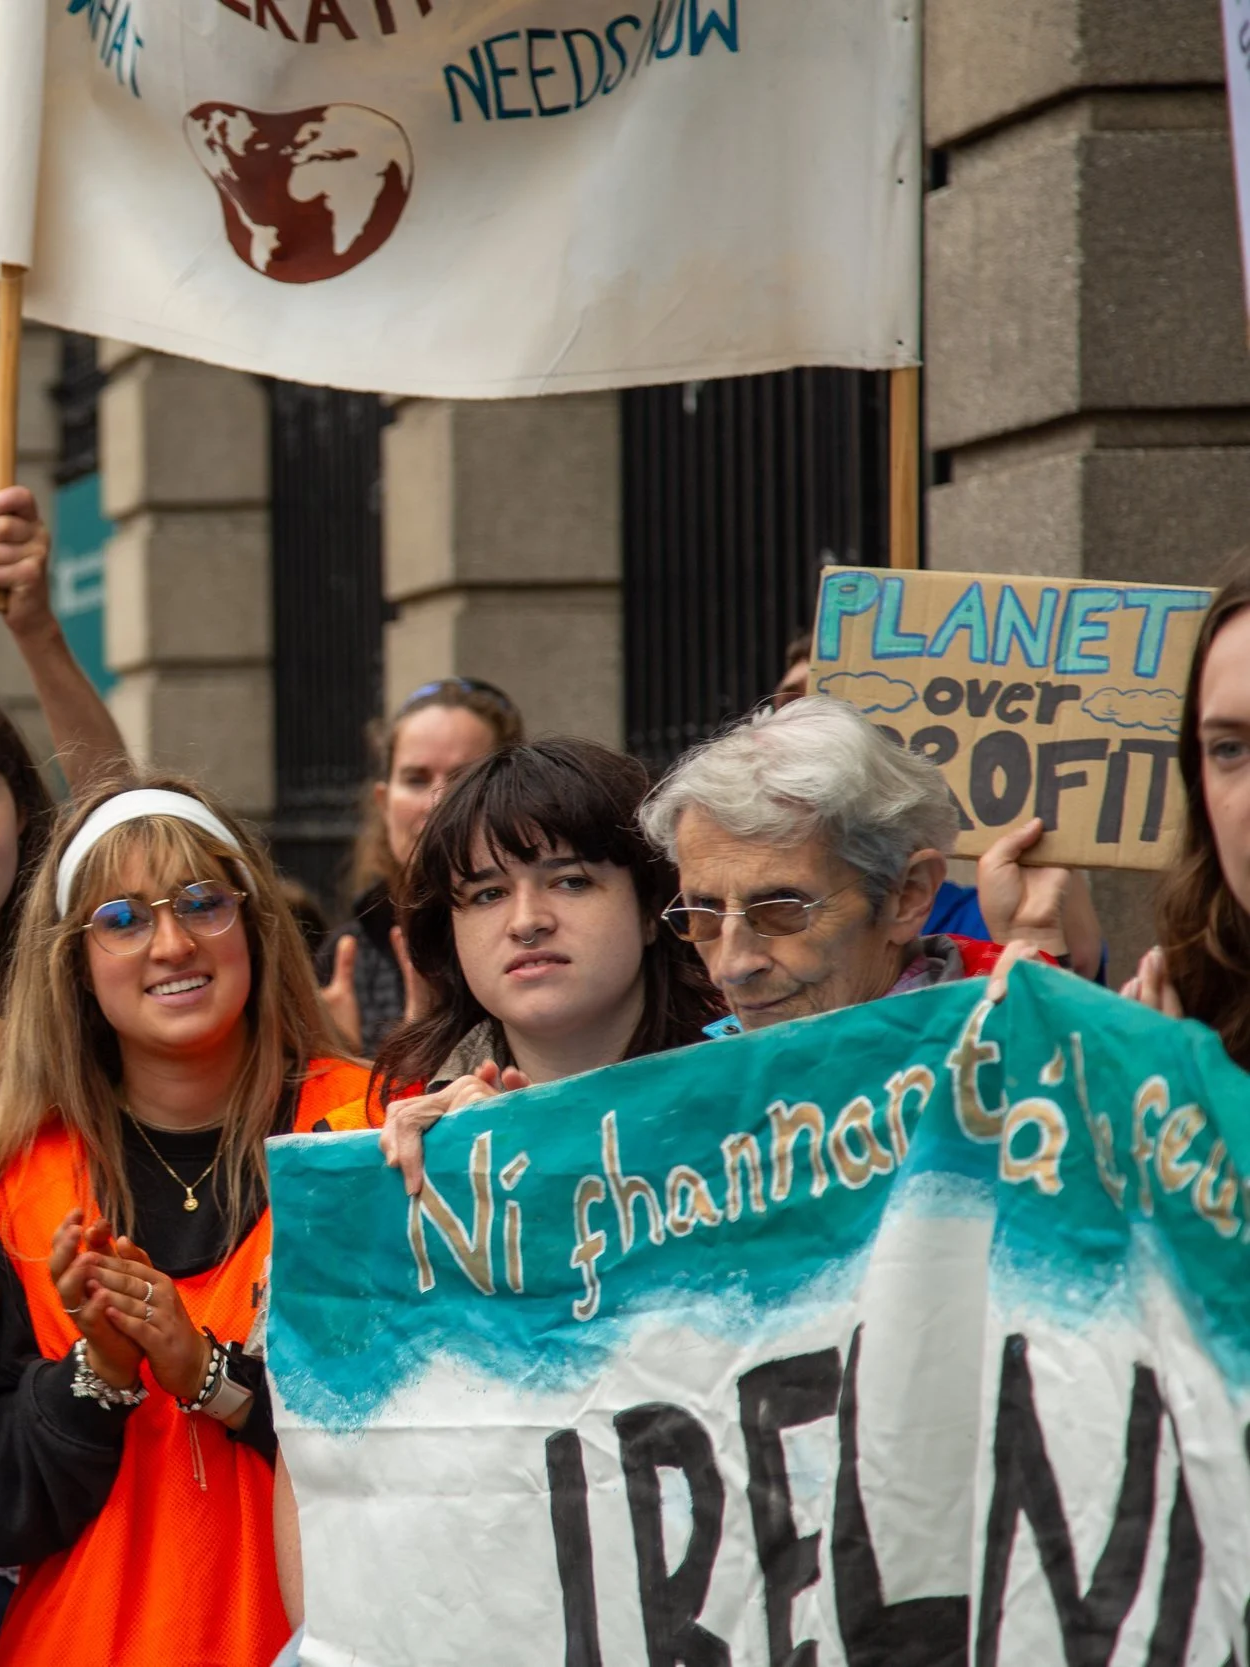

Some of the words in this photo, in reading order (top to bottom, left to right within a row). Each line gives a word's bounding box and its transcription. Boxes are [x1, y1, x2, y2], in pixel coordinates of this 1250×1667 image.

[442, 14, 642, 123] NEEDS
[817, 571, 1212, 679] PLANET
[878, 724, 1182, 844] ROFIT
